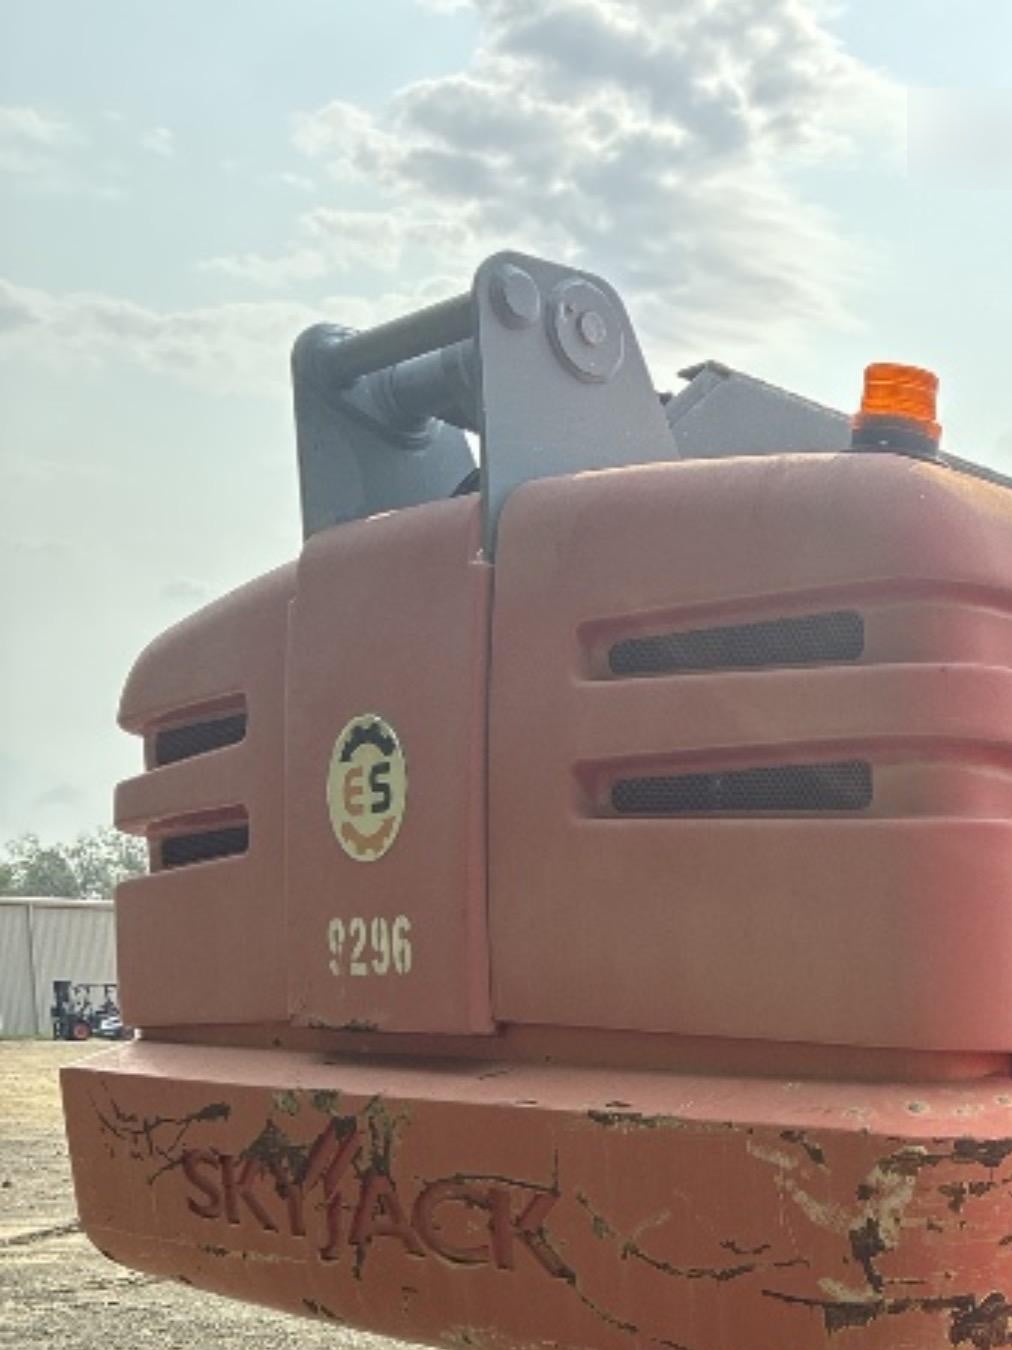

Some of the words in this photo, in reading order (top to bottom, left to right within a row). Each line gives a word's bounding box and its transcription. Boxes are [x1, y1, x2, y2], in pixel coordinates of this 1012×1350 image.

[343, 761, 391, 816] ES
[327, 913, 412, 976] 9296
[180, 1116, 577, 1284] SKYJACK
